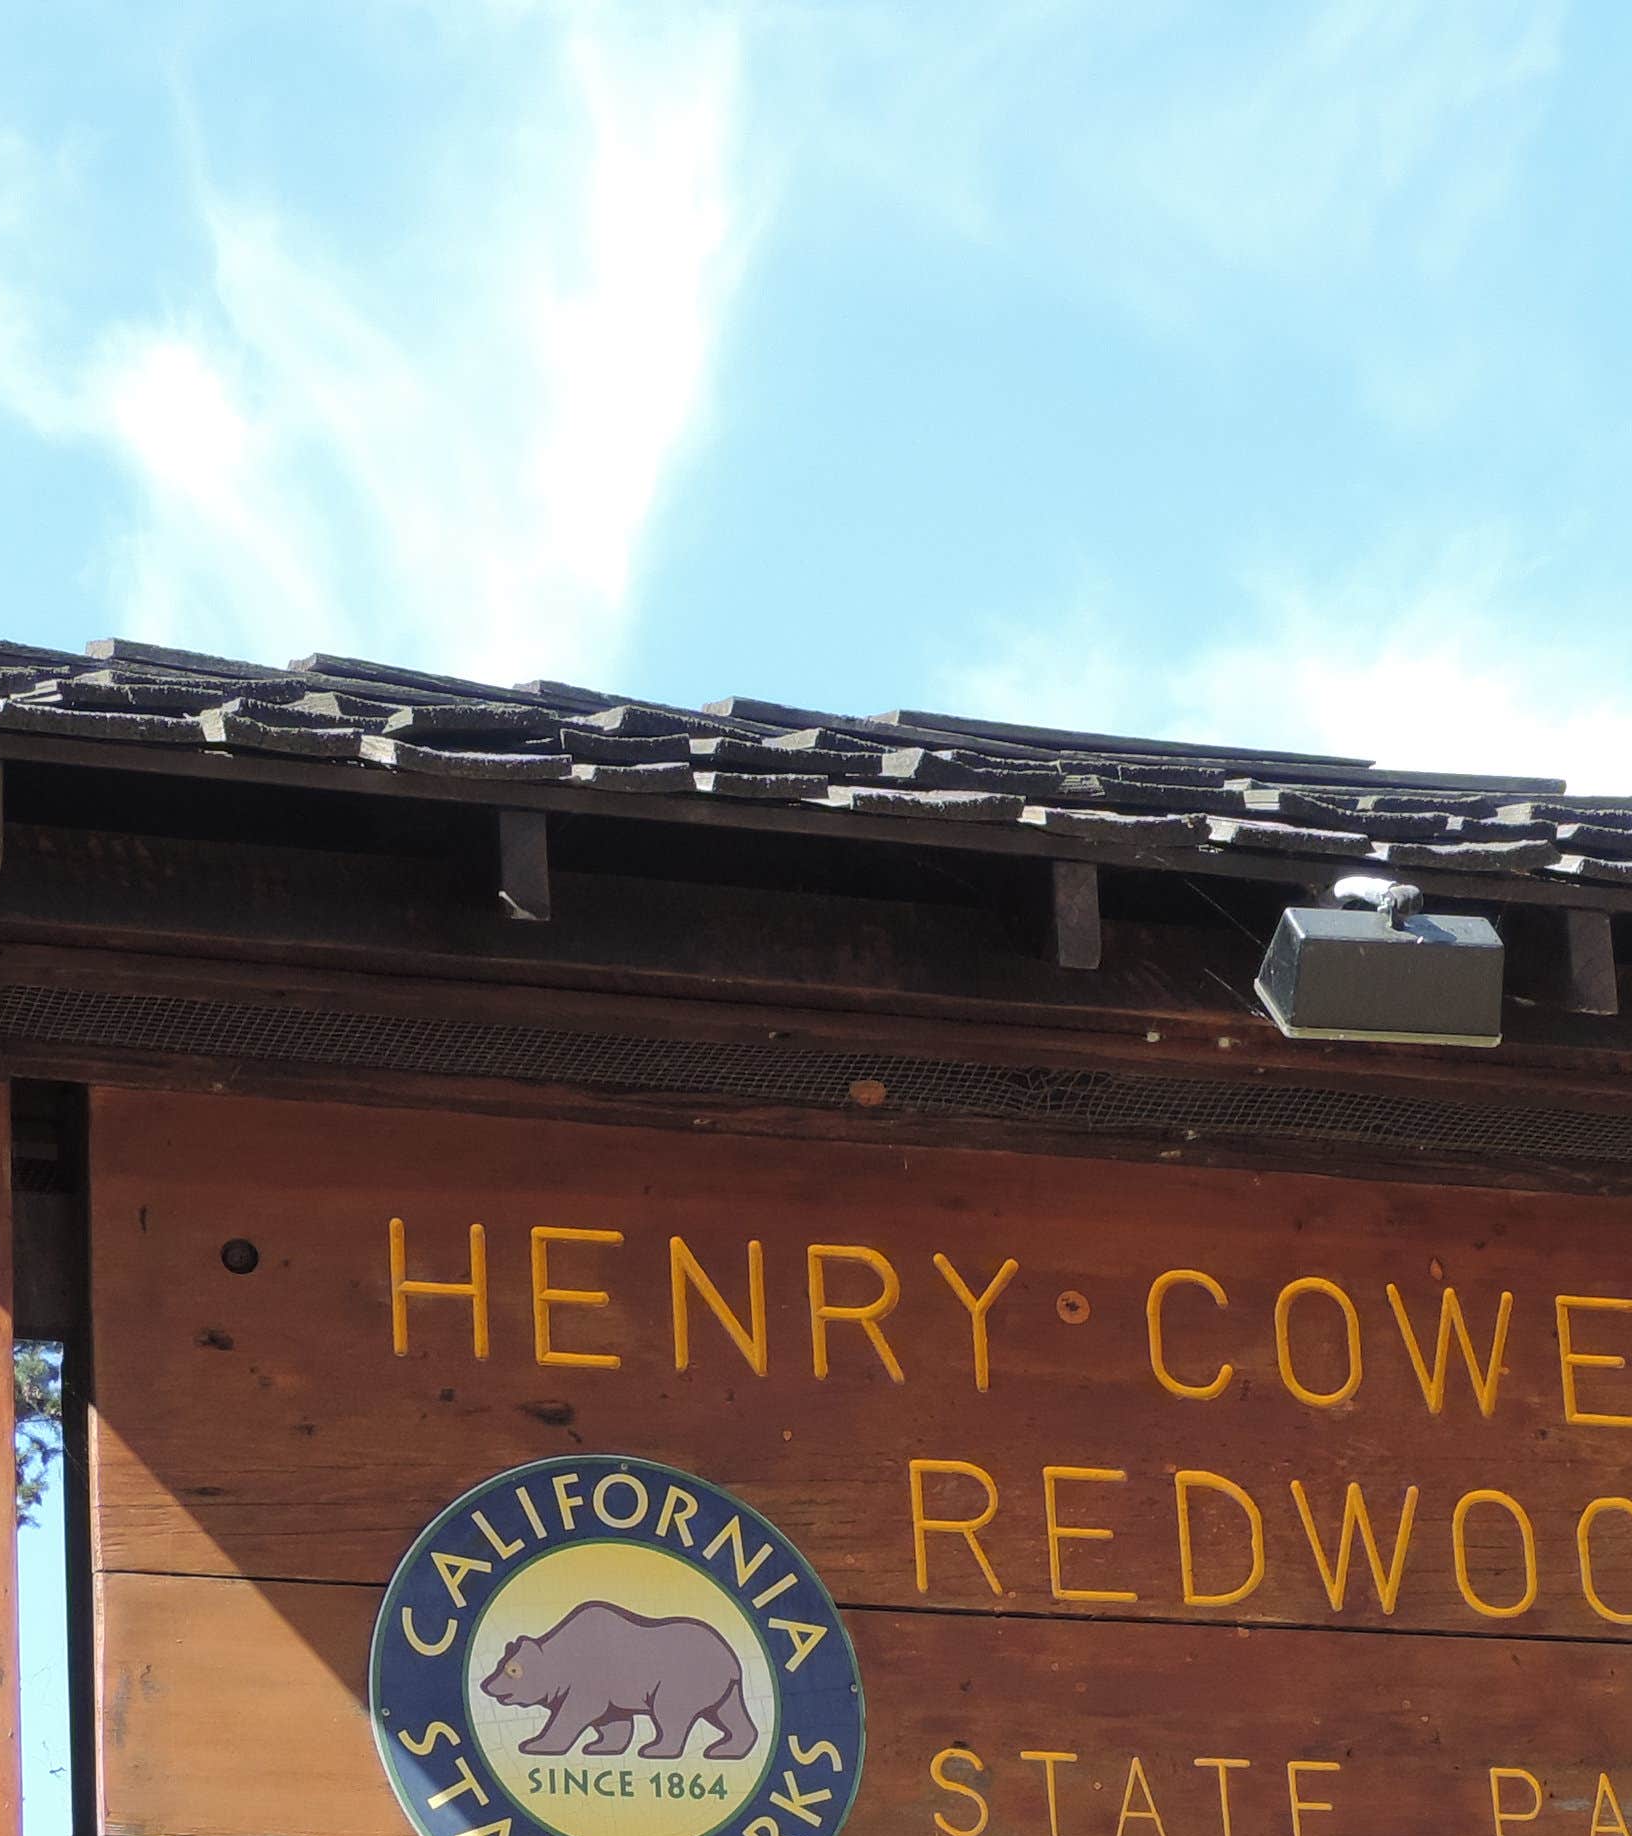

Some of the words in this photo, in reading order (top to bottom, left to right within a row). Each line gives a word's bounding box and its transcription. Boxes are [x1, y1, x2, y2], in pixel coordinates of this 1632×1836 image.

[388, 1216, 1020, 1394] HENRY
[400, 1471, 829, 1674] CALIFORNIA
[528, 1766, 636, 1800] SINCE
[649, 1771, 729, 1802] 1864
